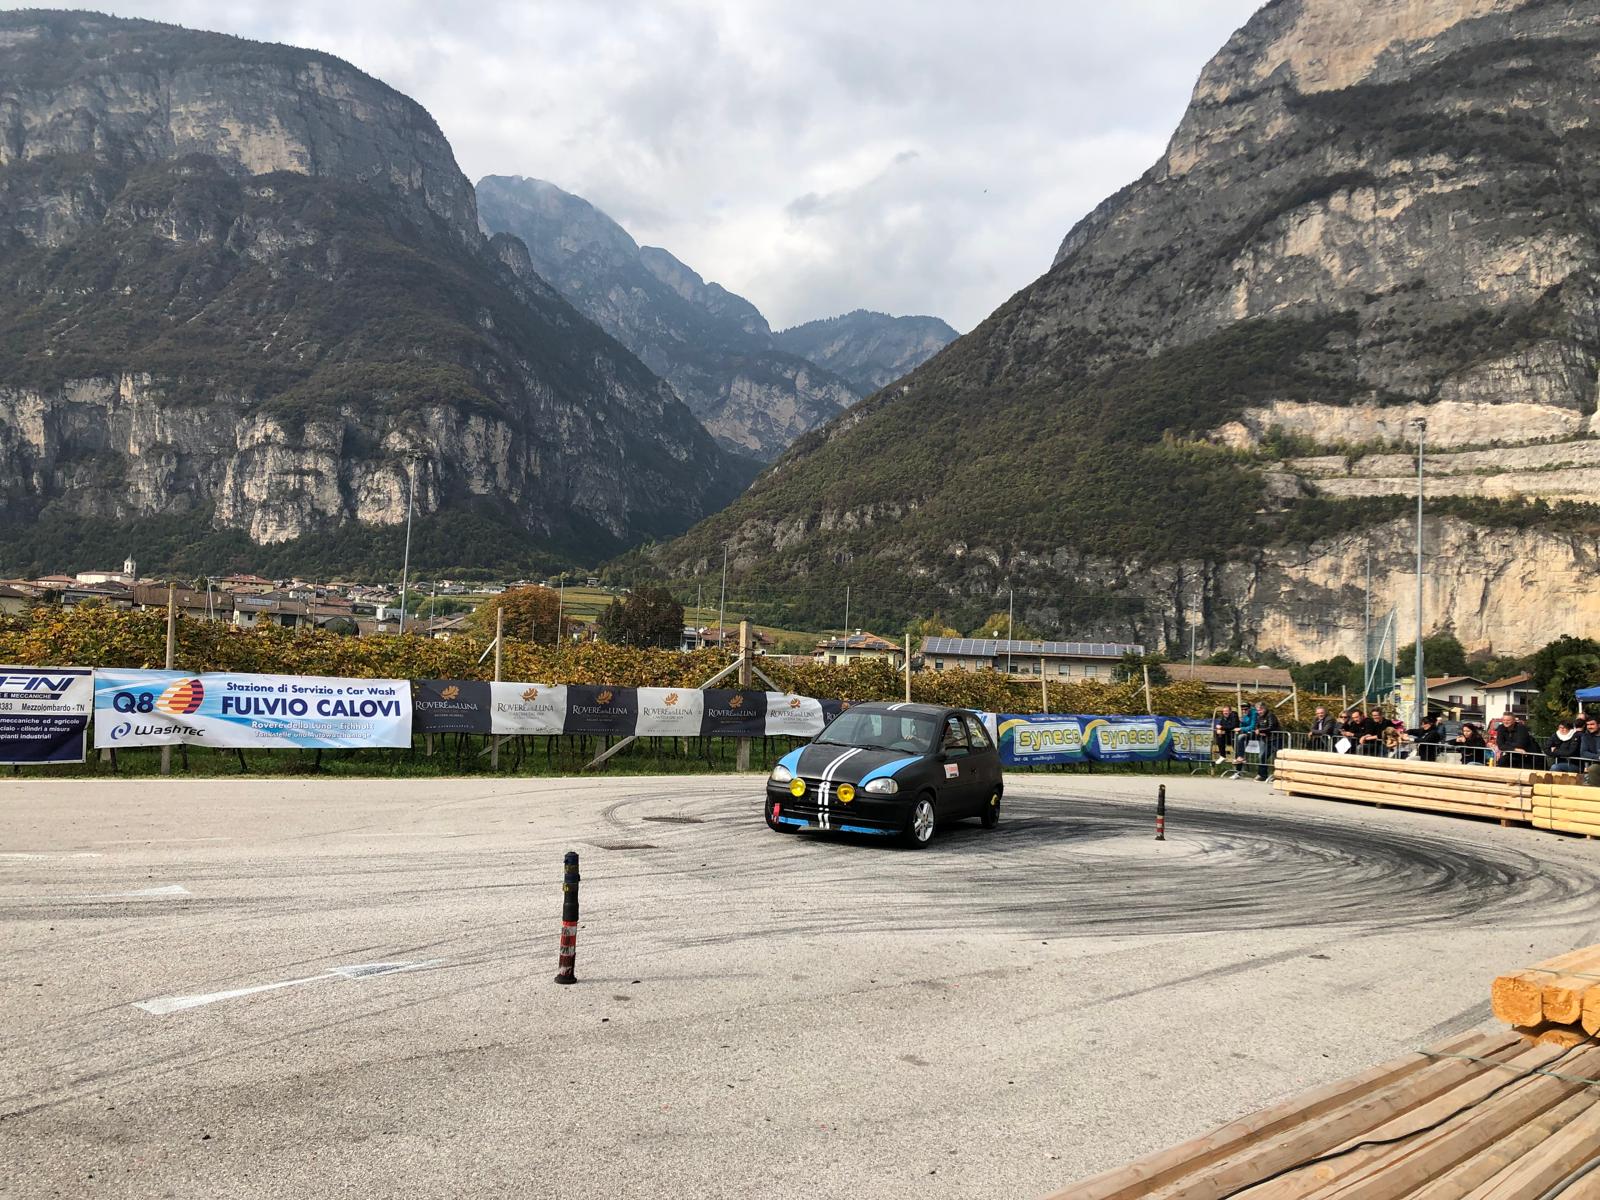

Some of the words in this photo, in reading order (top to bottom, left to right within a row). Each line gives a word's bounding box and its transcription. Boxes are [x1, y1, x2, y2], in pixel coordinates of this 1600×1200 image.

[227, 682, 274, 693] Stazione
[277, 683, 288, 693] di
[291, 684, 334, 695] Servizio
[346, 687, 365, 695] Car
[367, 687, 396, 696] Wash
[0, 702, 13, 710] 383
[21, 703, 71, 712] Mezzolombardo
[76, 704, 85, 712] TN
[113, 692, 154, 714] Q8
[222, 696, 308, 716] FULVIO
[316, 699, 401, 717] CALOVI
[456, 702, 479, 711] LUNA
[535, 704, 554, 712] LUNA
[608, 706, 628, 715] LUNA
[287, 720, 309, 729] della
